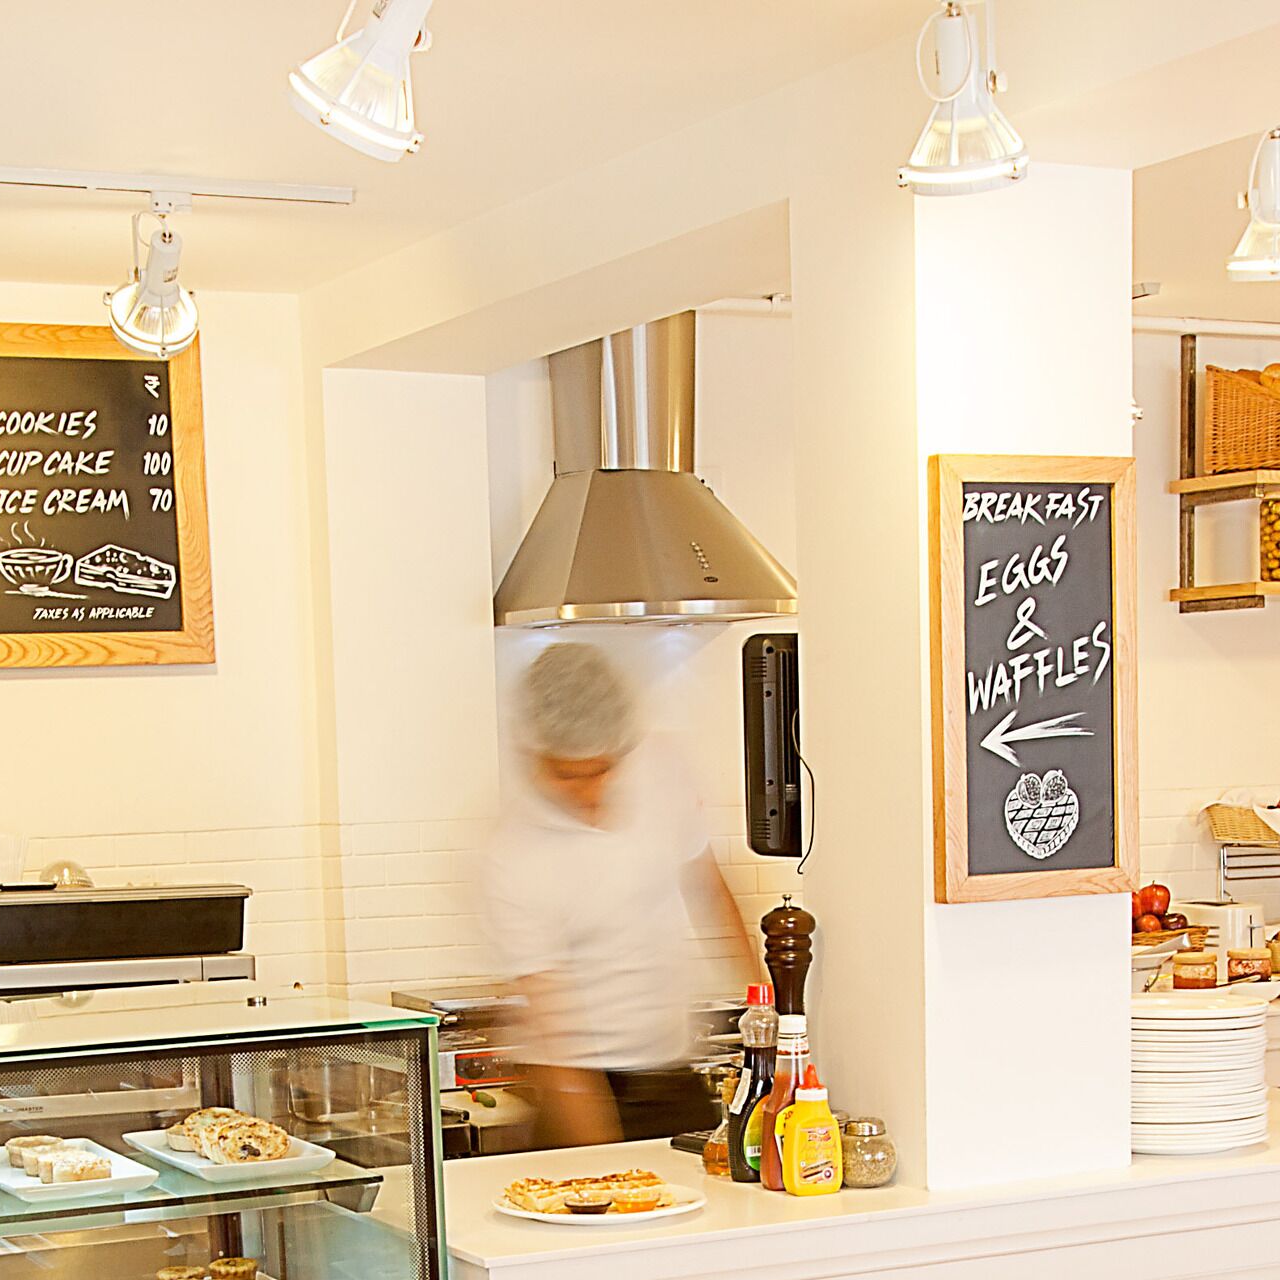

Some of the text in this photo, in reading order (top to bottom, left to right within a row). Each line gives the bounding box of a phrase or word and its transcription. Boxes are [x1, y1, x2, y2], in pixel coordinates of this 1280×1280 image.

[147, 413, 169, 437] 10
[143, 451, 171, 476] 100
[43, 488, 130, 521] CREAM
[149, 488, 173, 513] 70
[974, 533, 1068, 607] EGGS
[32, 606, 155, 622] TAXES AS APPLICABLE
[1006, 596, 1049, 650] &
[967, 621, 1111, 716] WAFFLES
